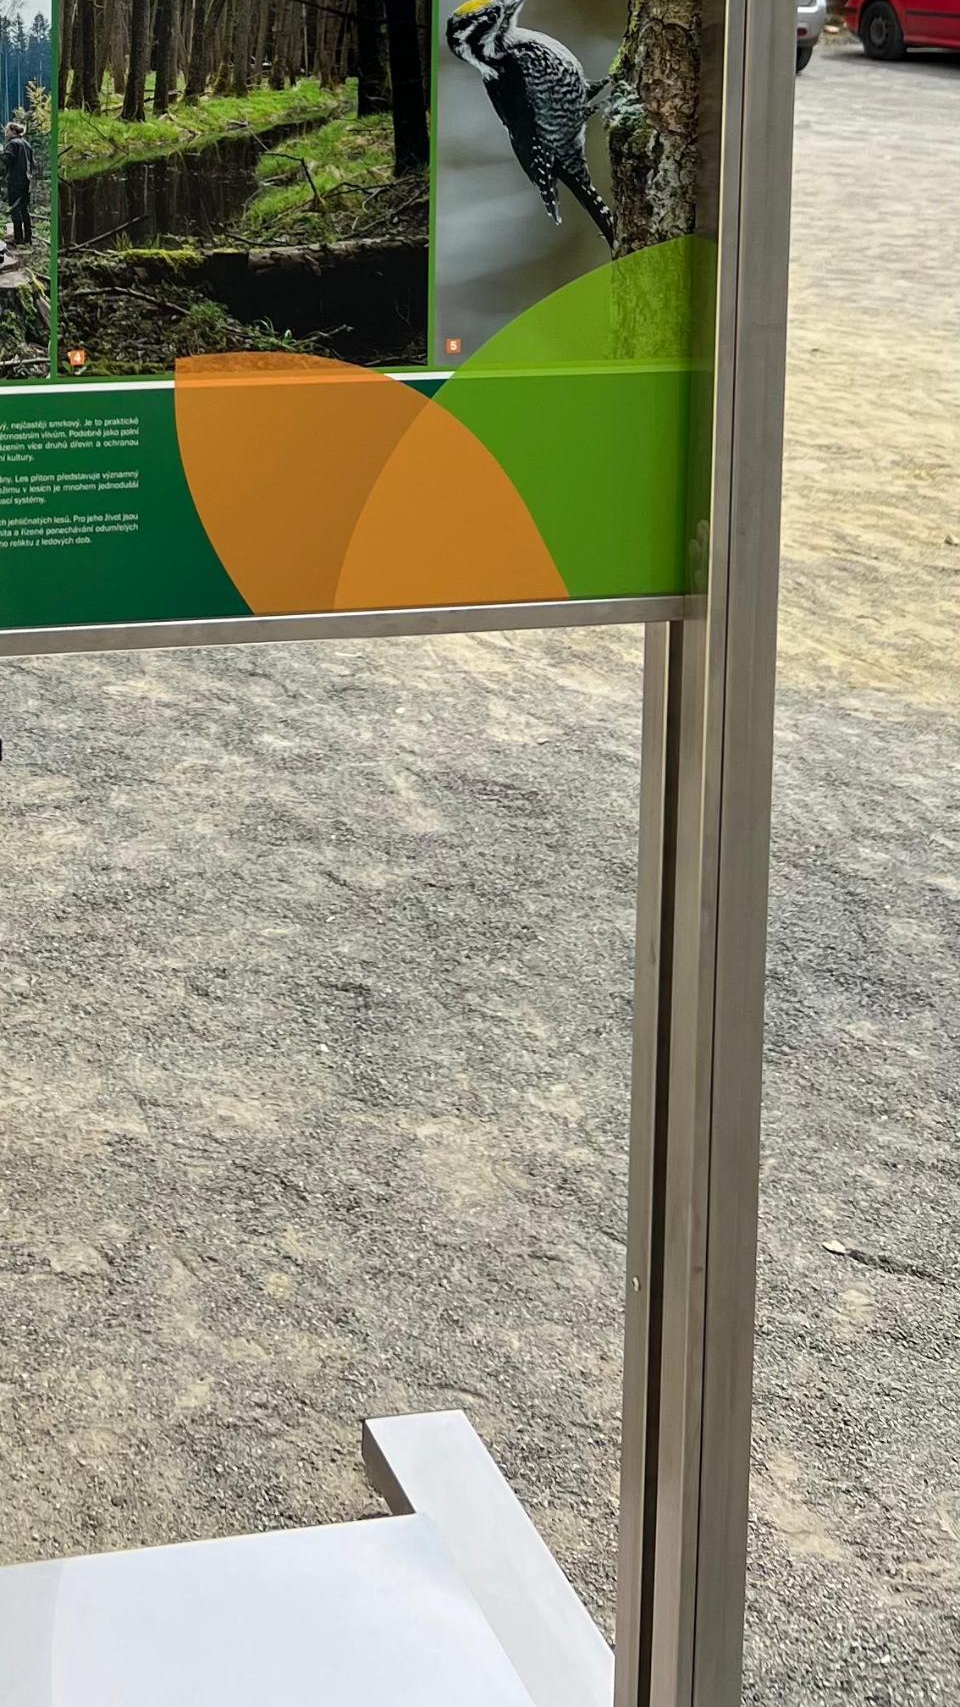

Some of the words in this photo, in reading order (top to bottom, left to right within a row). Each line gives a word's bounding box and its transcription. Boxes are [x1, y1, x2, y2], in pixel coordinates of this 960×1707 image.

[450, 340, 457, 350] 5
[73, 352, 81, 362] 4
[102, 427, 118, 438] jako
[120, 426, 138, 437] polní
[27, 442, 42, 450] více
[45, 440, 67, 449] druhů
[70, 439, 92, 448] dřevin
[30, 473, 54, 483] přitom
[29, 484, 51, 492] lesích
[53, 483, 60, 493] je
[62, 482, 96, 491] mnohem
[86, 513, 103, 523] jeho
[104, 512, 121, 520] život
[122, 511, 138, 521] jsou
[20, 527, 43, 535] řízené
[75, 535, 90, 543] dob.
